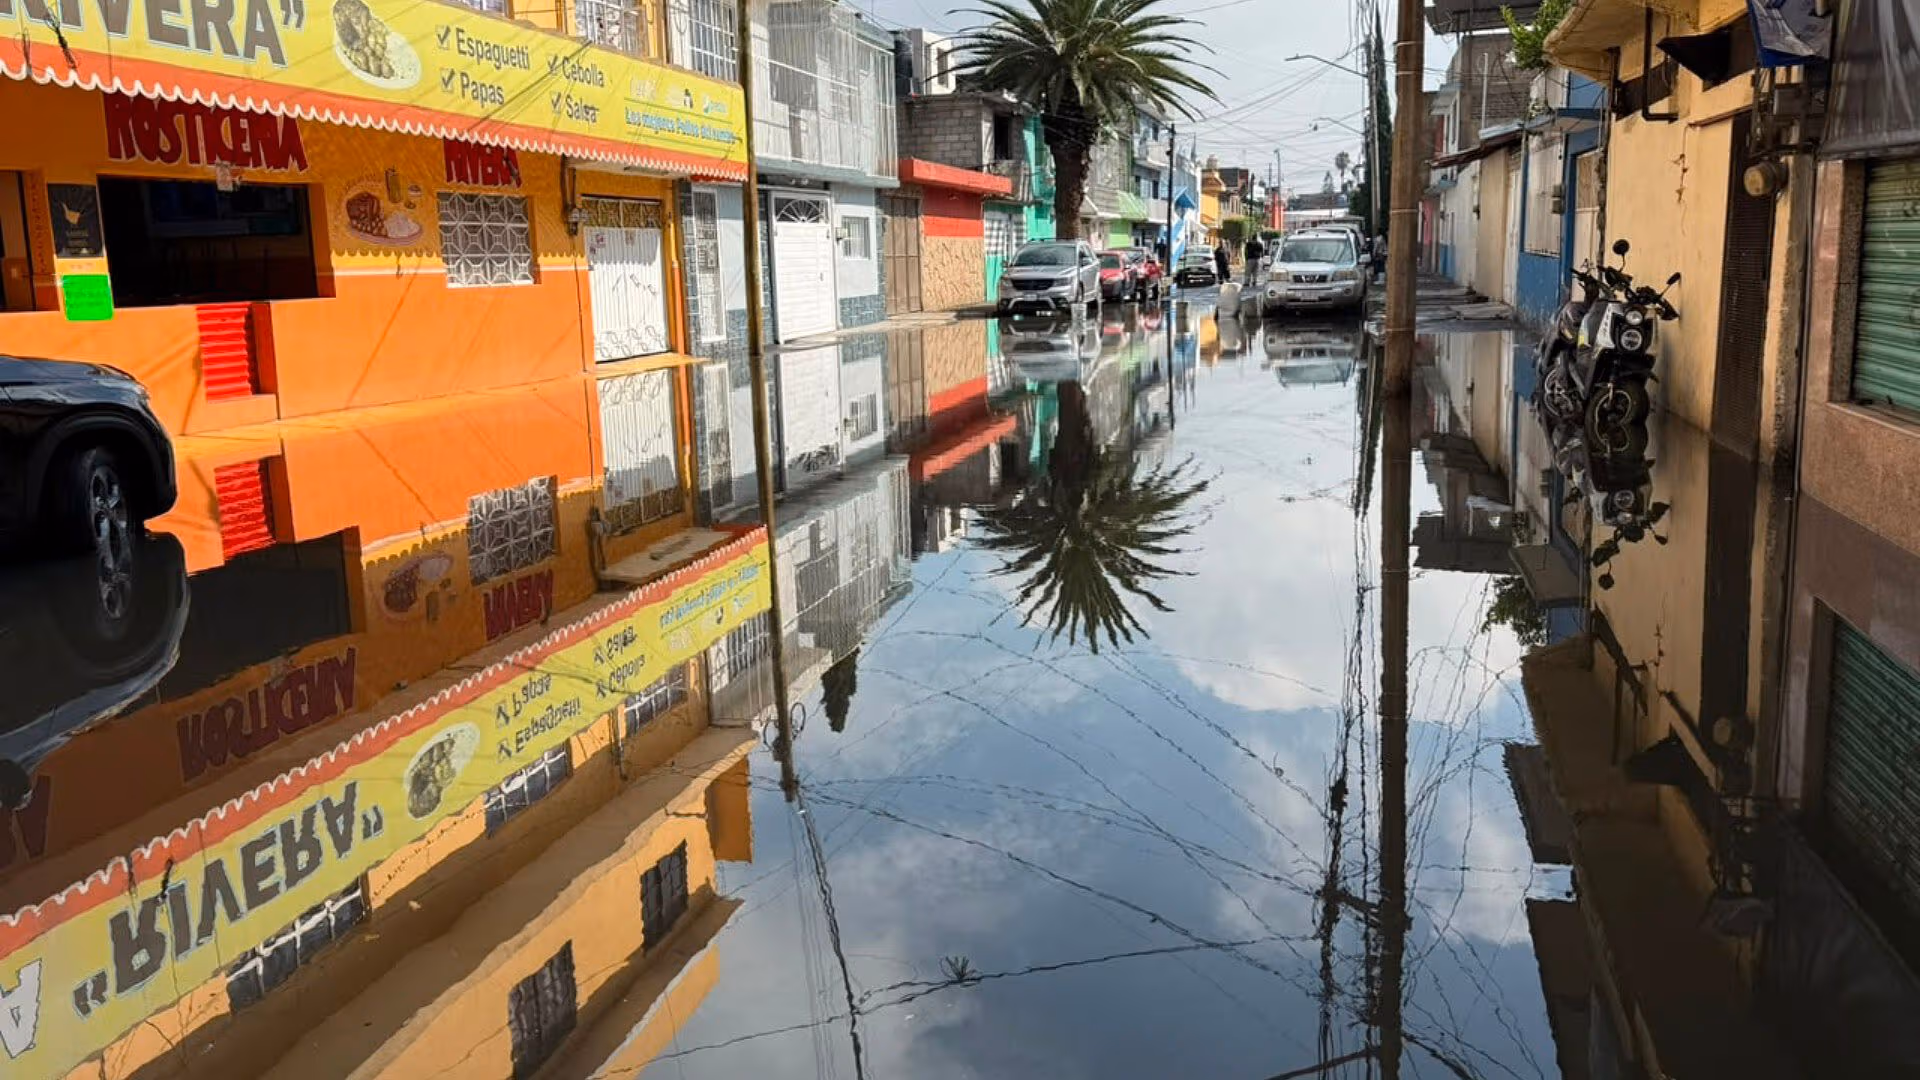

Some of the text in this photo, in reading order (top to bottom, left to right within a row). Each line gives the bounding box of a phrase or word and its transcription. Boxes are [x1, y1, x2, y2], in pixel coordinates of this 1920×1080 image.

[455, 27, 530, 70] Espaguetti
[562, 56, 605, 87] Cebolla
[460, 72, 505, 108] Papas
